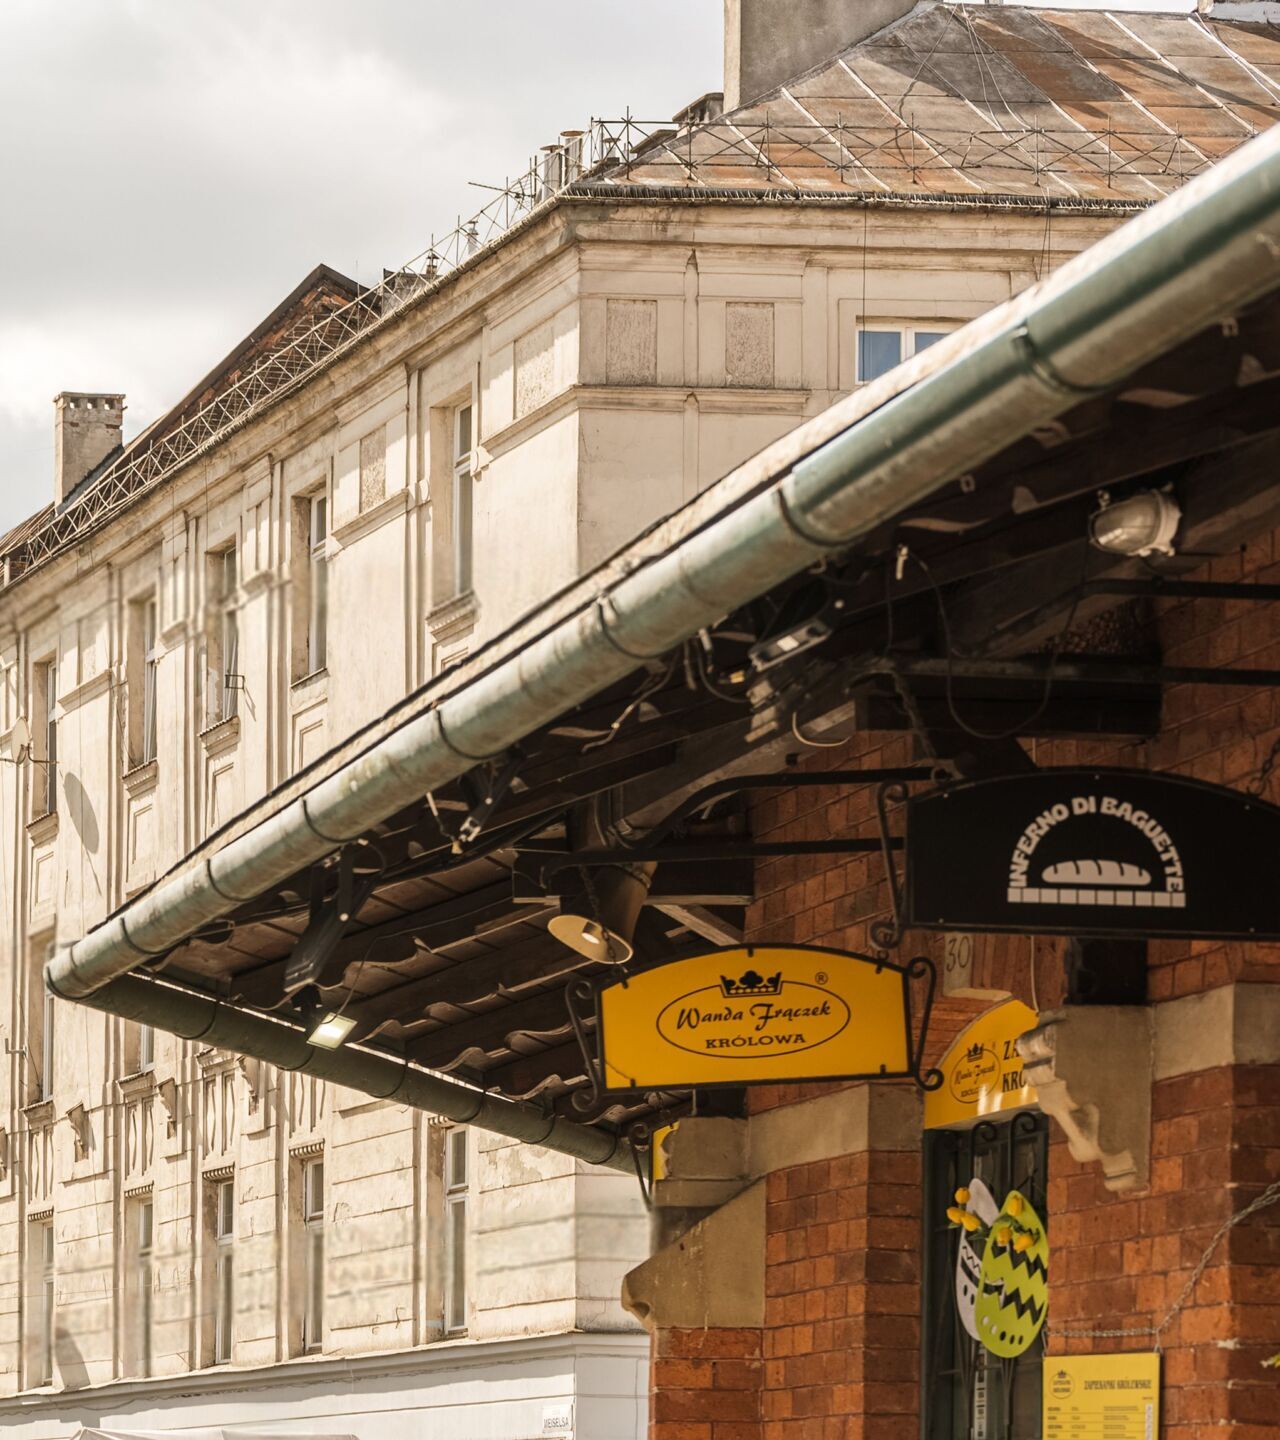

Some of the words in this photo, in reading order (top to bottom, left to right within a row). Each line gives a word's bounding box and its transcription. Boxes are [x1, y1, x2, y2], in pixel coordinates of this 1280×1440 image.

[1009, 803, 1070, 888] INFERNO
[1071, 796, 1096, 816] DI
[1100, 796, 1185, 893] BAGUETTE
[946, 935, 972, 973] 30
[676, 1007, 744, 1030] Wanda
[749, 1001, 832, 1032] Frączek
[705, 1033, 806, 1050] KRÓLOWA
